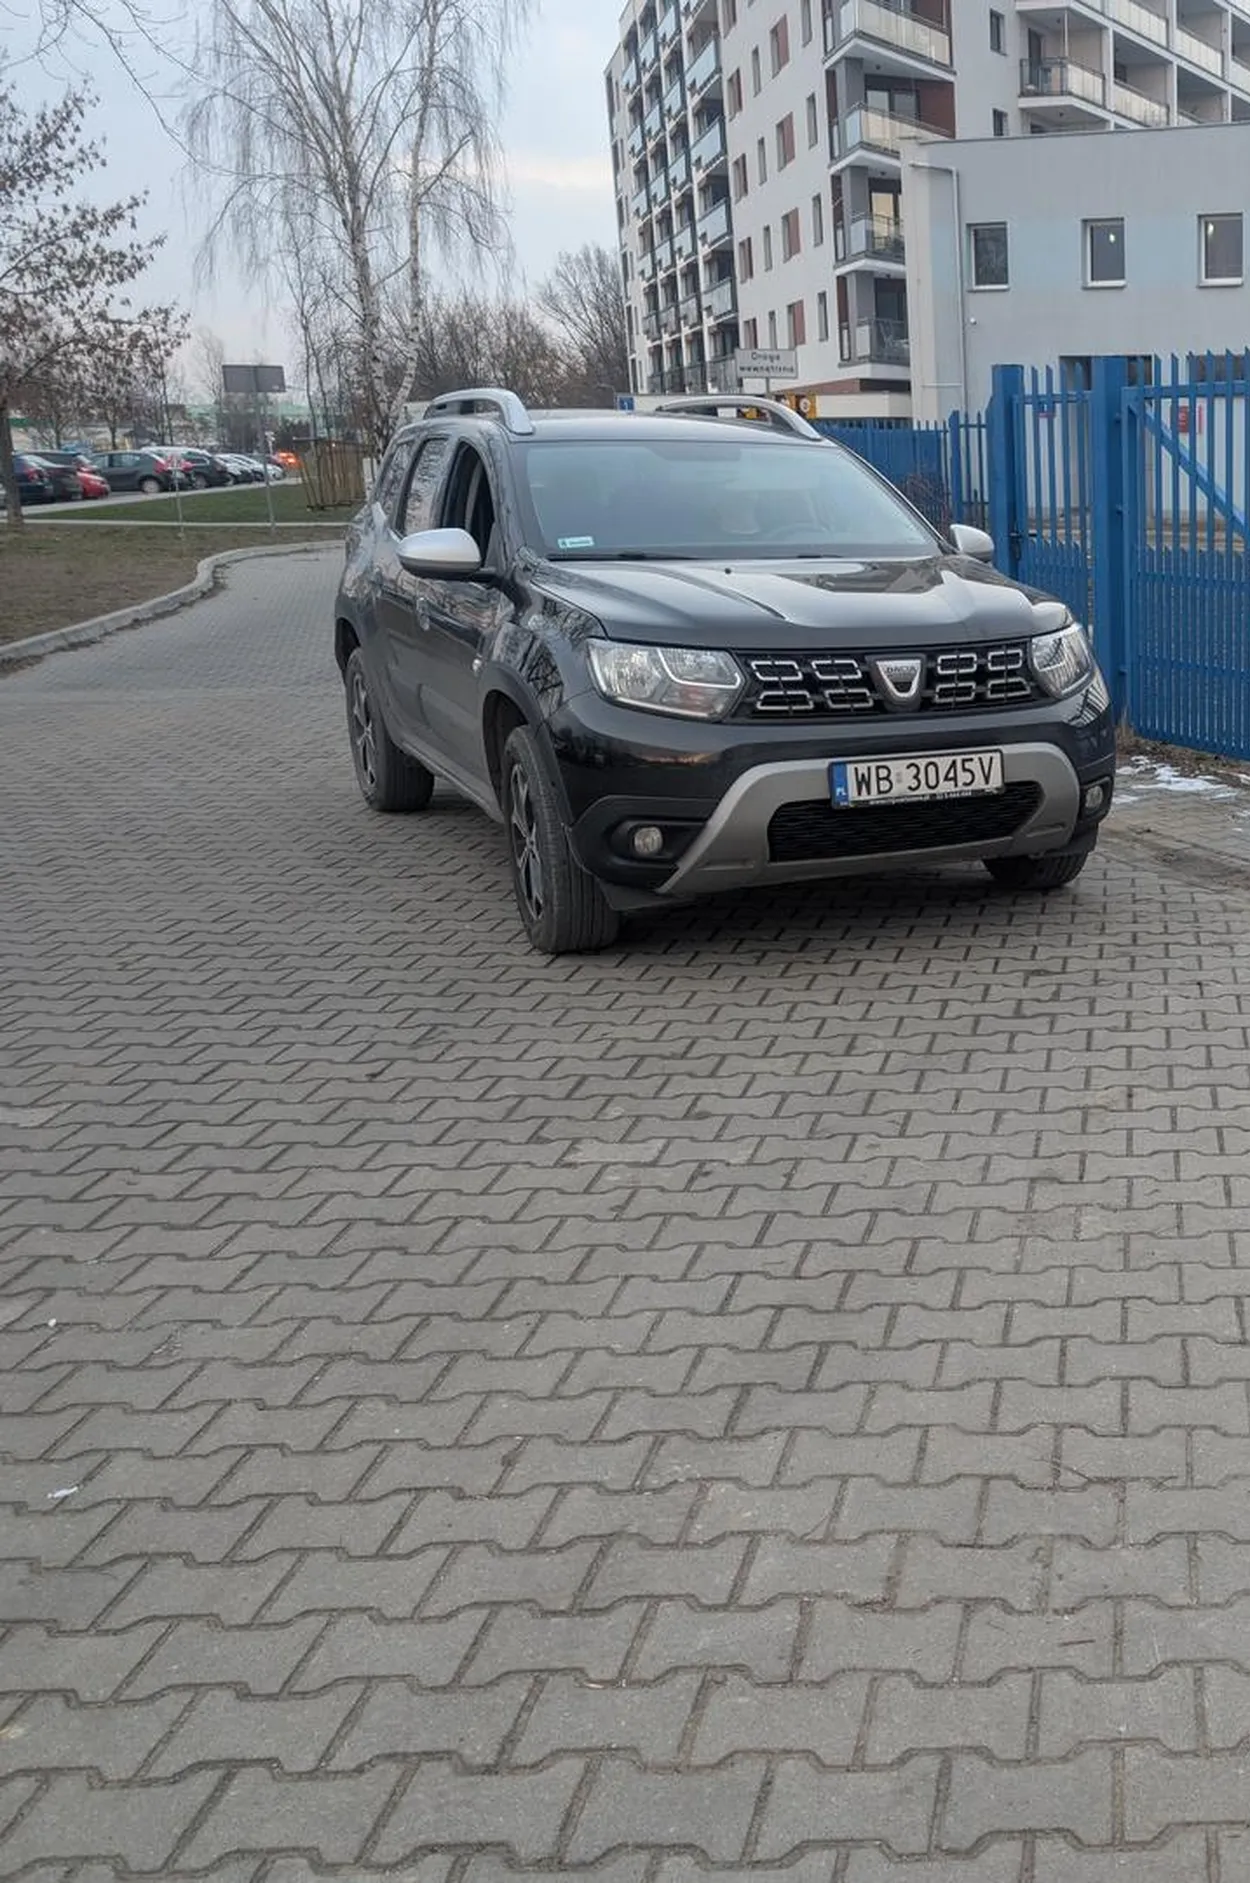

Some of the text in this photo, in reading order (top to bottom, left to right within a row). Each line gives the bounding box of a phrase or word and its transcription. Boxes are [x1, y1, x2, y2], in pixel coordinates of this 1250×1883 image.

[854, 756, 993, 796] WB 3045V
[836, 787, 847, 796] PL
